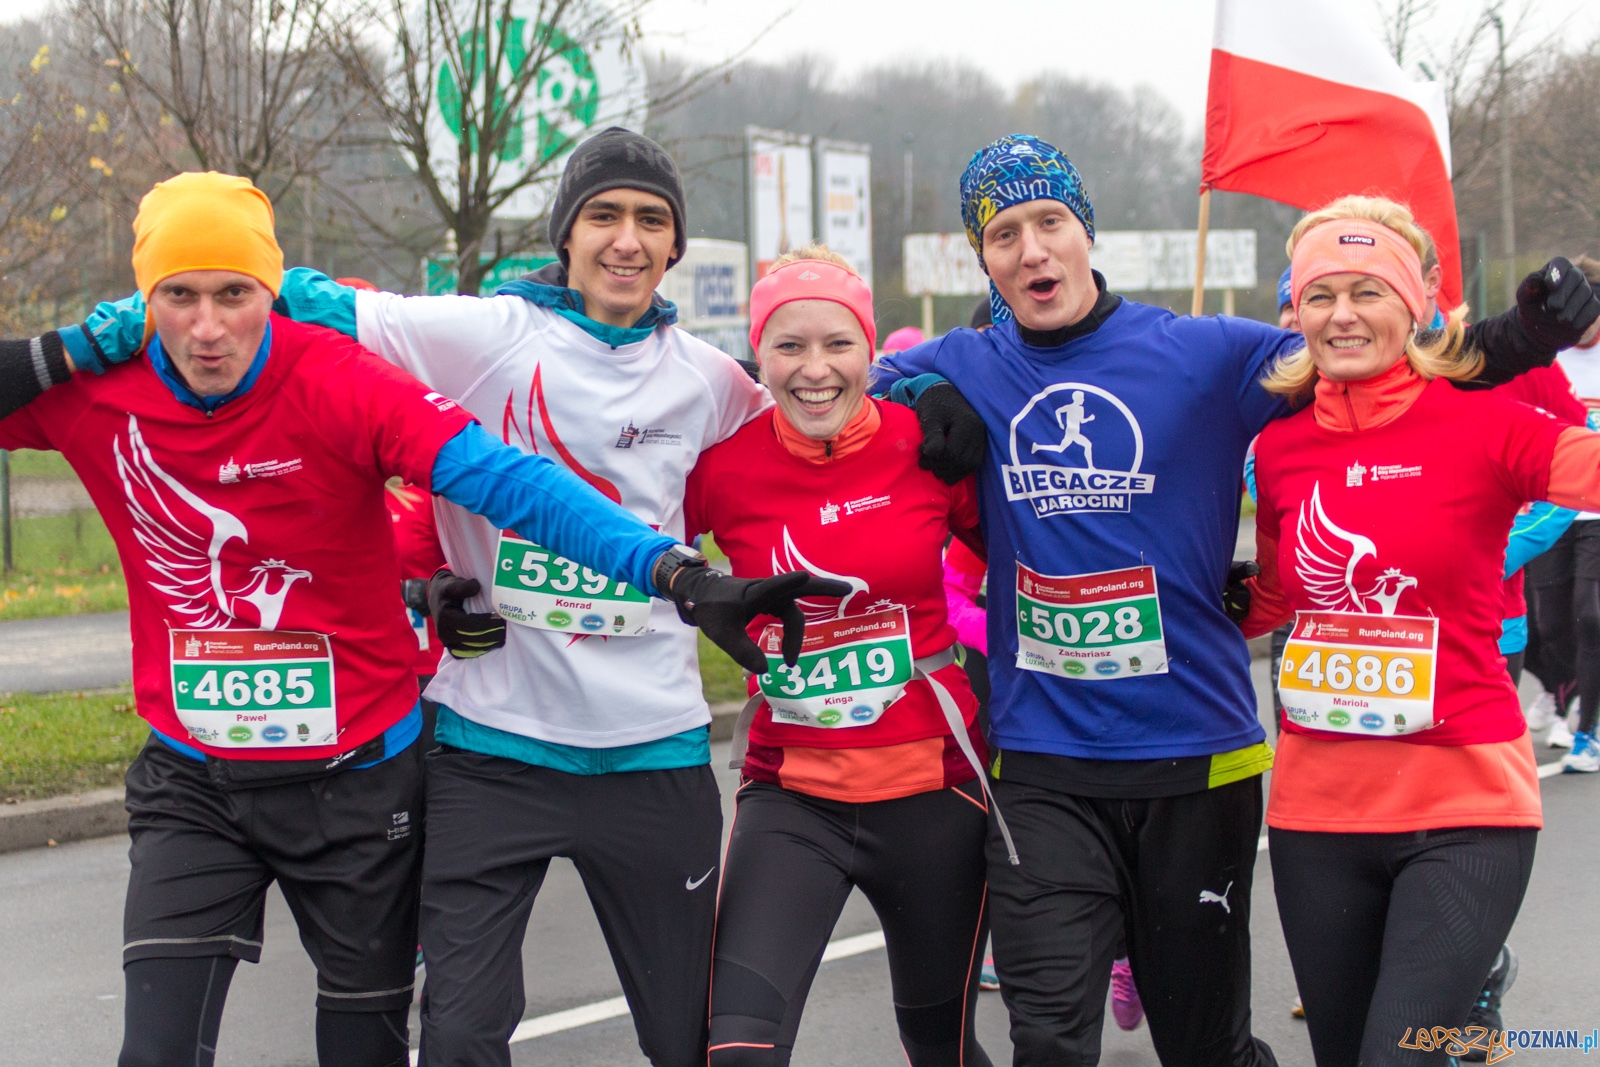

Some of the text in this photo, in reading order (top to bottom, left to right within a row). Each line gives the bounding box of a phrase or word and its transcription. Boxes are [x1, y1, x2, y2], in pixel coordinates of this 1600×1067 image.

[1008, 470, 1147, 494] BIEGACZE
[1037, 495, 1124, 513] JAROCIN
[501, 550, 629, 596] C 539
[1080, 580, 1145, 596] RunPoland.org
[499, 603, 523, 614] GRUPA
[555, 599, 592, 610] Konrad
[833, 620, 897, 638] RunPoland.org
[1020, 606, 1143, 644] C 5028
[1358, 628, 1424, 642] RunPoland.org
[253, 642, 319, 652] RunPoland.org
[1058, 648, 1112, 658] Zachariasz
[1026, 658, 1050, 668] LUXMED
[762, 647, 895, 696] C 3419
[1284, 650, 1415, 695] D 4686
[177, 668, 315, 707] C 4685
[824, 695, 854, 706] Kinga
[1333, 697, 1369, 708] Mariola
[236, 713, 267, 722] Paweł
